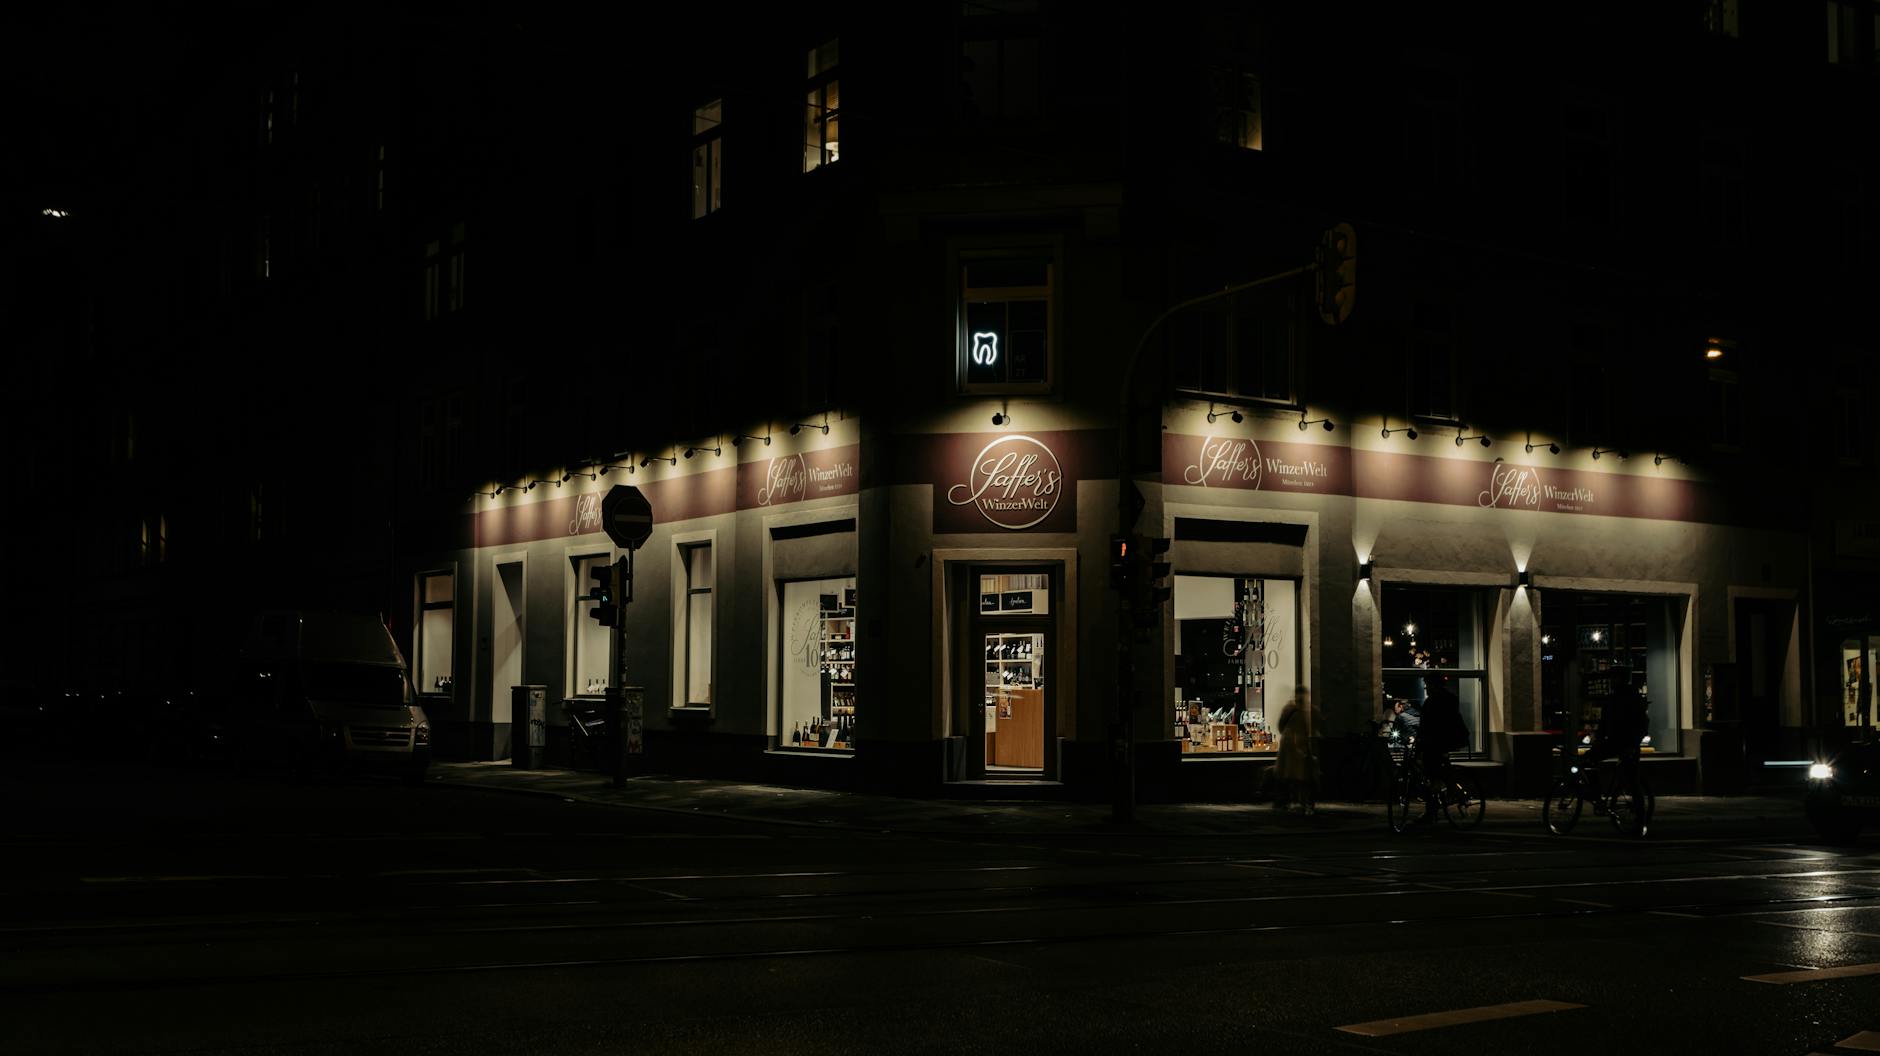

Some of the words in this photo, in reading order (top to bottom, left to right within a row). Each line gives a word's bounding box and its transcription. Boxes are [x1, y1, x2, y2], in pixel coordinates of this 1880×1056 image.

[808, 463, 853, 482] WinzerWelt
[1266, 457, 1328, 477] WinzerWelt
[1543, 484, 1595, 503] WinzerWelt
[982, 498, 1049, 512] WinzerWelt
